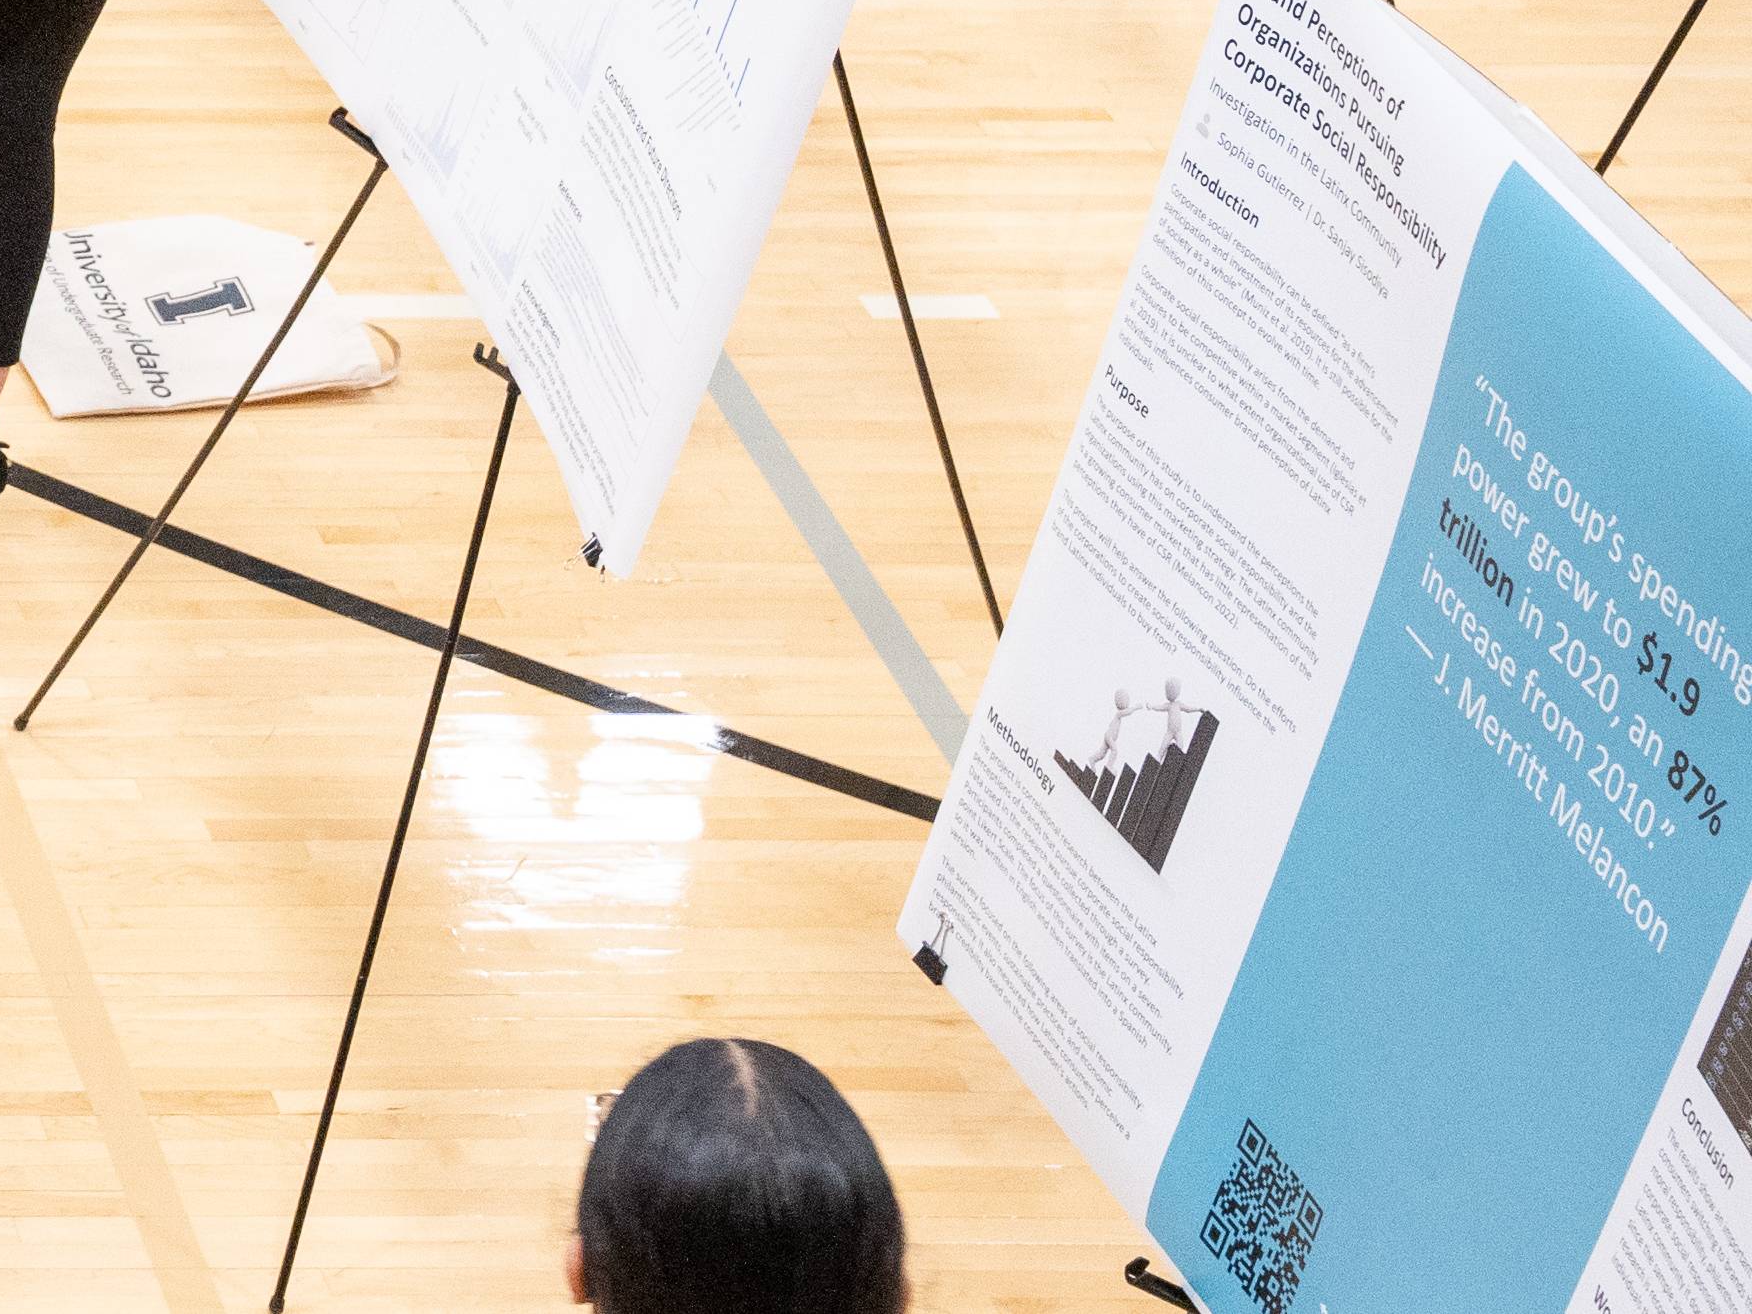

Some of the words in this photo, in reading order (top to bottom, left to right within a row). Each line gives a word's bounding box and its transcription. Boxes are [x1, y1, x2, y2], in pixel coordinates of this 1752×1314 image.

[1237, 2, 1347, 109] Organizations
[1347, 96, 1404, 177] Pursuing
[1306, 8, 1385, 103] Perceptions
[1385, 96, 1405, 120] of
[1180, 151, 1259, 228] Introduction
[1208, 76, 1285, 147] Investigation
[1285, 137, 1299, 158] in
[1299, 150, 1319, 177] the
[1319, 167, 1350, 208] Latinx
[1349, 199, 1402, 268] Community
[1216, 131, 1255, 170] Sophia
[1255, 162, 1305, 212] Gutierrez
[1311, 210, 1326, 233] Dr.
[1326, 224, 1356, 264] Sanjay
[1354, 254, 1389, 300] Sisodiya
[1223, 37, 1310, 120] Corporate
[1311, 108, 1355, 164] Social
[1354, 151, 1446, 270] Responsibility
[114, 323, 141, 338] of
[126, 338, 172, 398] Idaho
[144, 276, 255, 326] I
[1104, 363, 1149, 419] Purpose
[1452, 443, 1530, 538] power
[1527, 531, 1599, 612] grew
[1602, 597, 1632, 649] to
[1635, 630, 1701, 717] $1.9
[1475, 374, 1526, 461] “The
[1526, 451, 1625, 563] group's
[1628, 553, 1752, 705] spending
[986, 705, 1055, 796] Methodology
[1420, 551, 1516, 687] increase
[1520, 667, 1584, 762] from
[1586, 743, 1675, 850] 2010.”
[1438, 496, 1514, 608] trillion
[1518, 586, 1543, 639] in
[1548, 620, 1620, 728] 2020,
[1628, 713, 1663, 767] an
[1666, 748, 1728, 837] 87%
[1433, 652, 1450, 695] J.
[1456, 675, 1548, 802] Merritt
[1548, 781, 1668, 953] Melancon
[1680, 1096, 1734, 1190] Conclusion
